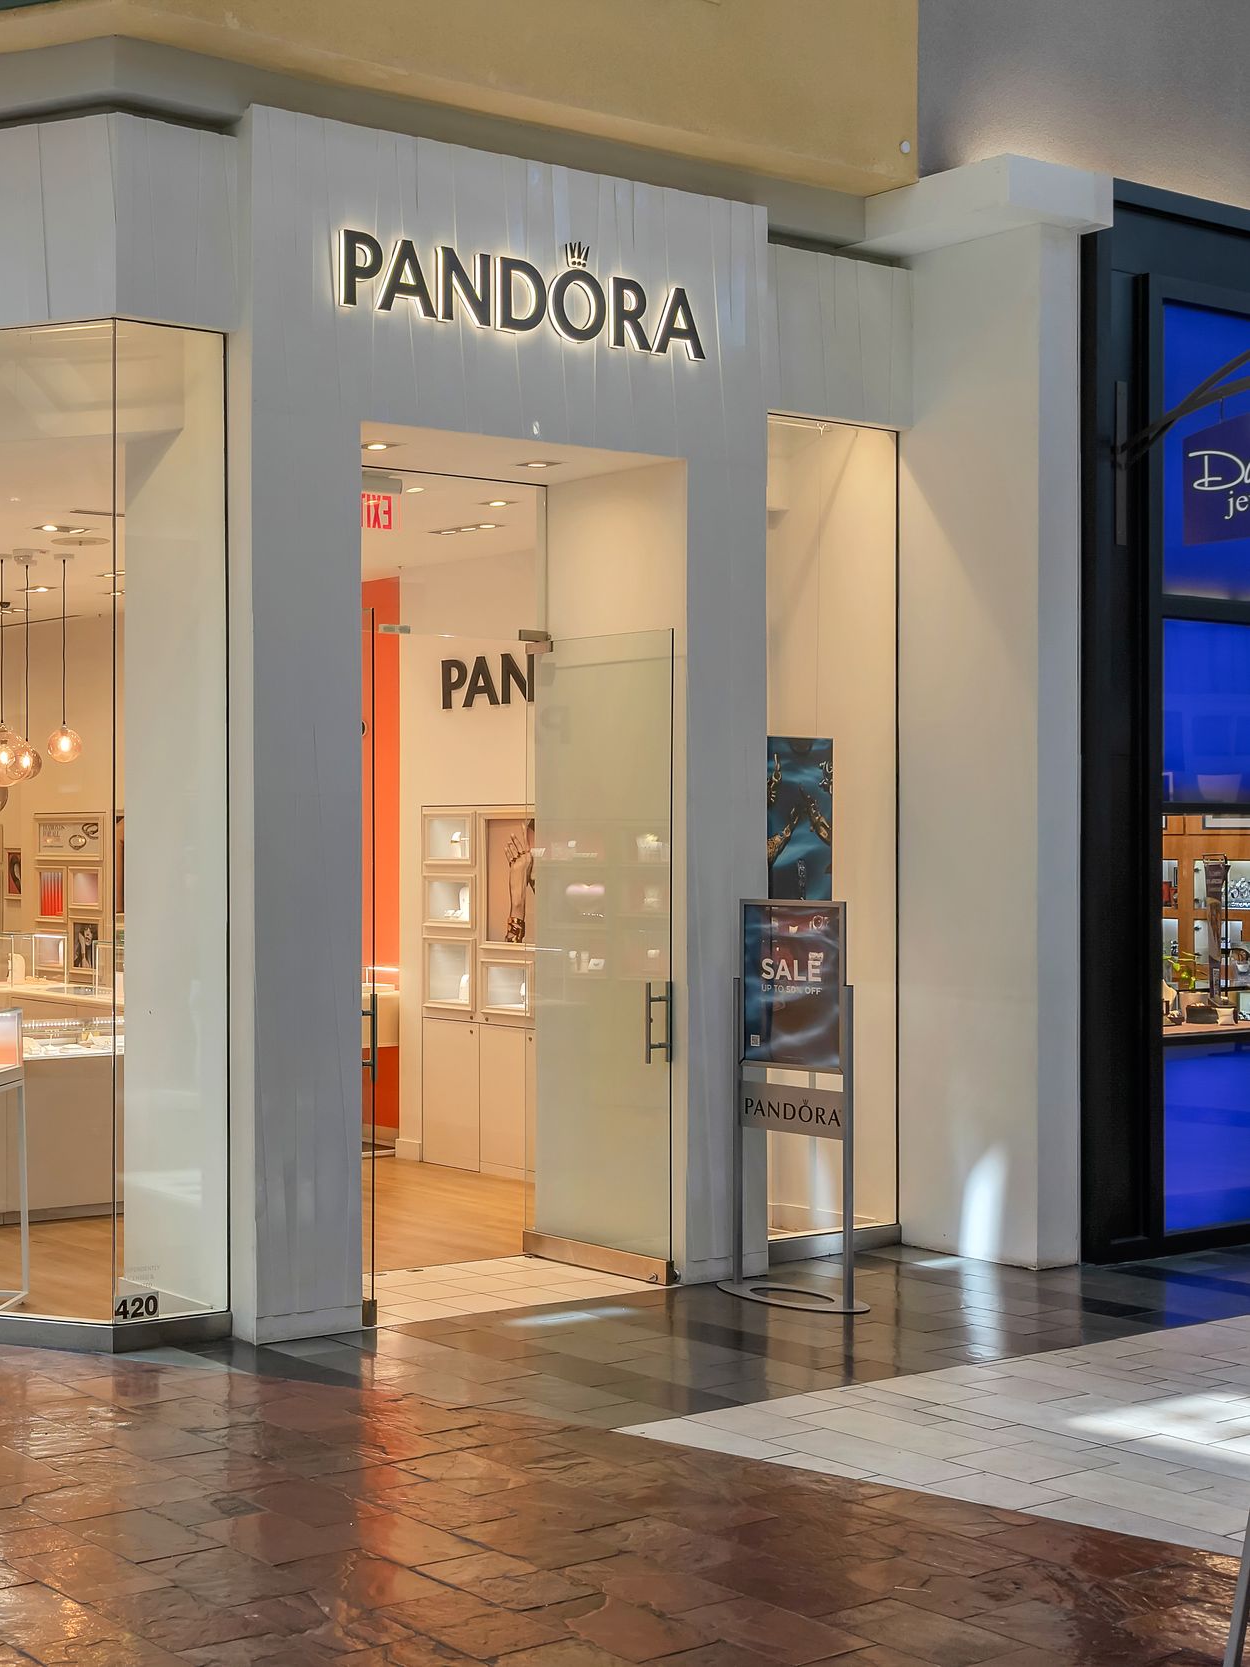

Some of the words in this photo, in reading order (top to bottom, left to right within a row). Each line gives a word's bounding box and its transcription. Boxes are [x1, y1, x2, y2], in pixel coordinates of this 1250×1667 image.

[338, 228, 706, 362] PANDORA
[1188, 450, 1250, 490] D
[1224, 491, 1250, 520] je
[440, 653, 535, 710] PAN
[761, 958, 822, 982] SALE
[761, 984, 772, 992] UP
[774, 984, 784, 993] TO
[744, 1098, 841, 1127] PANDORA
[114, 1295, 158, 1320] 420
